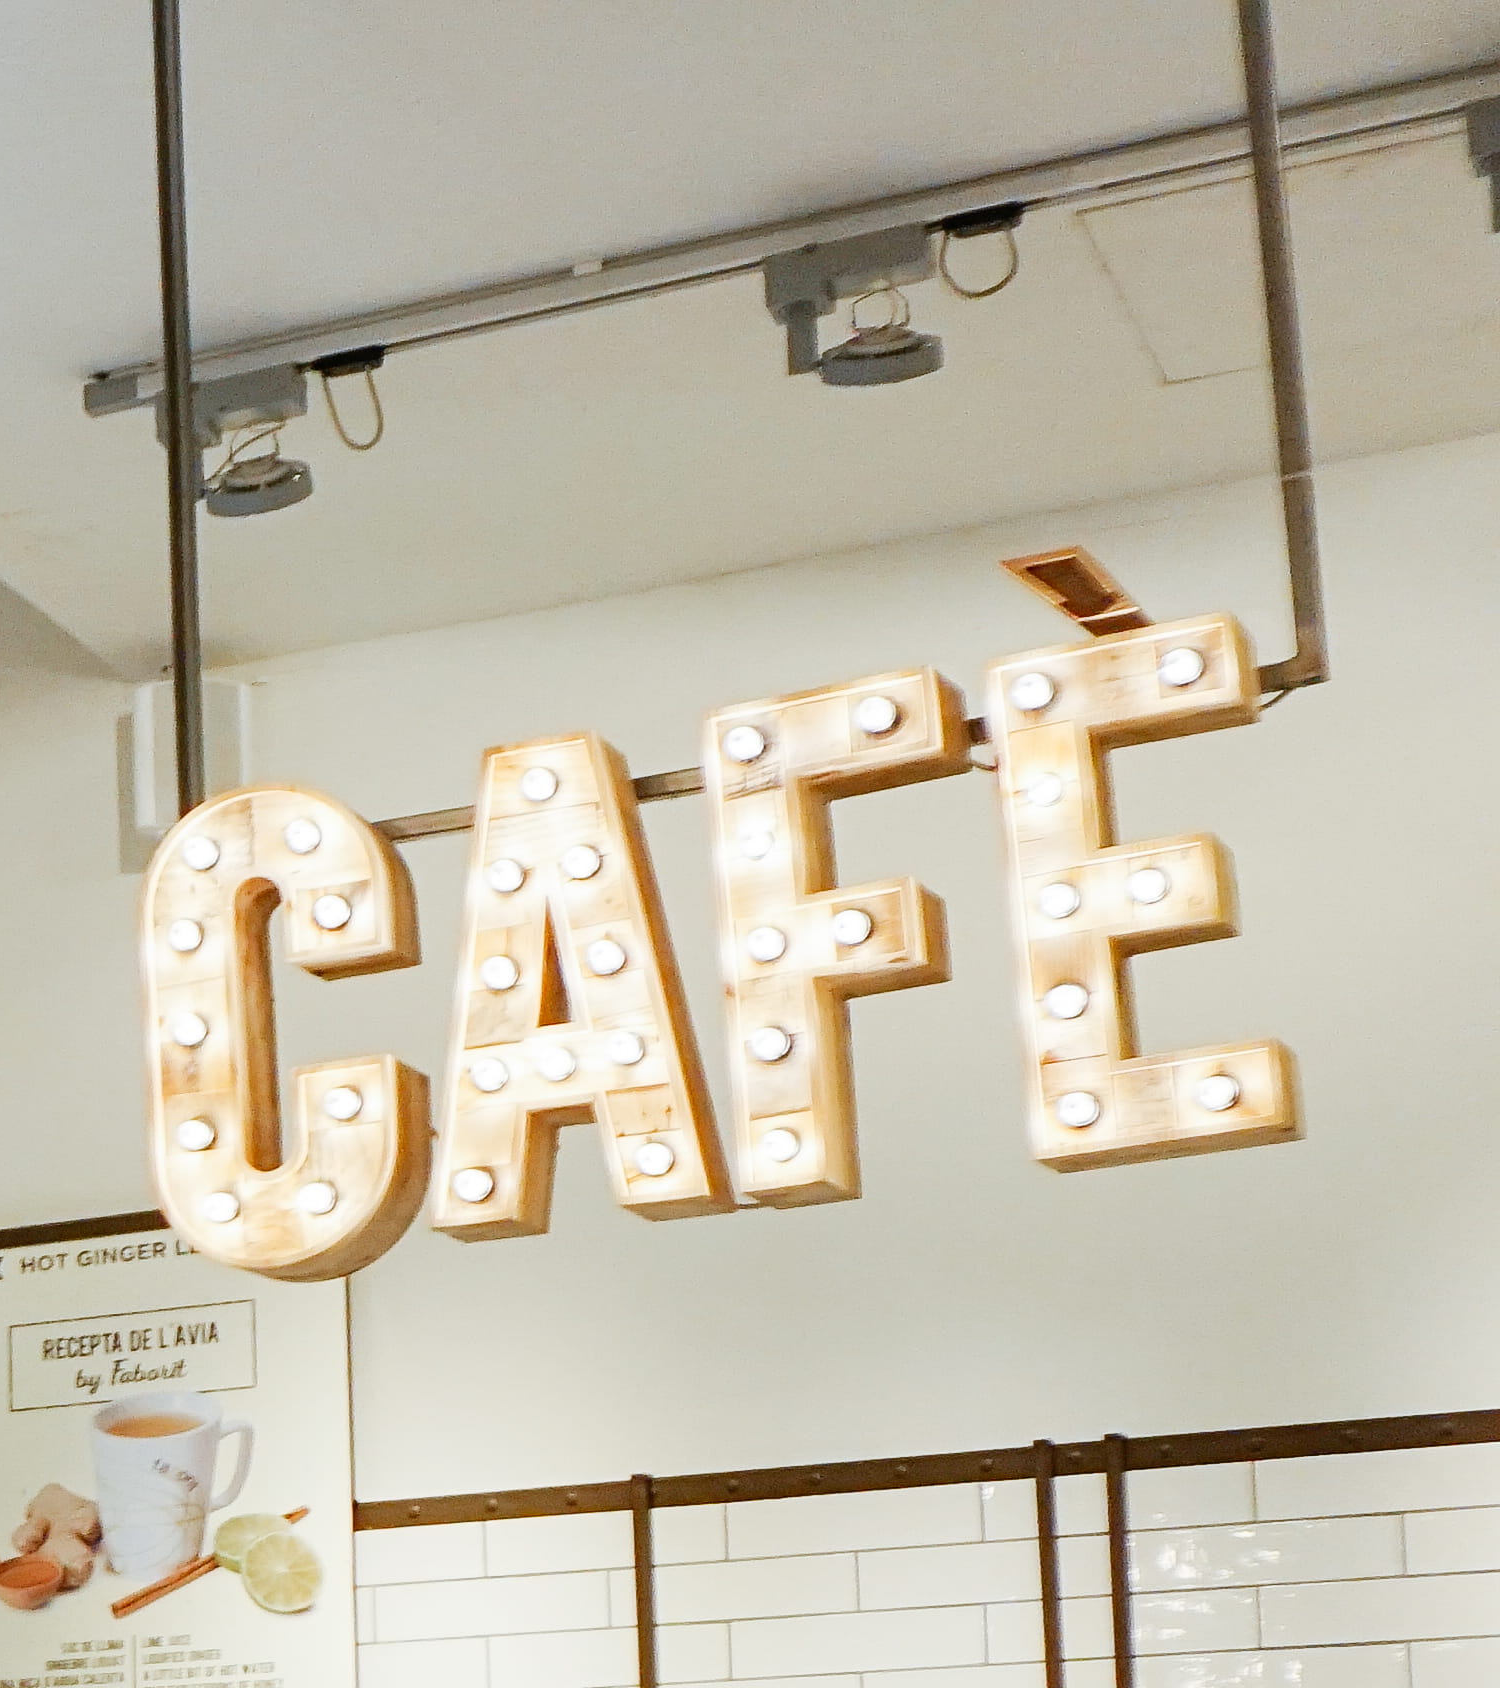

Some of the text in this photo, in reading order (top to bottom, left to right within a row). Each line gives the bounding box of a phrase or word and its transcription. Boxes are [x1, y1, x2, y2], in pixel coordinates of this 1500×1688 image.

[19, 1251, 66, 1274] HOT
[77, 1241, 166, 1269] GINGER
[42, 1331, 123, 1359] RECEPTA
[130, 1327, 153, 1352] DE
[75, 1368, 102, 1395] by
